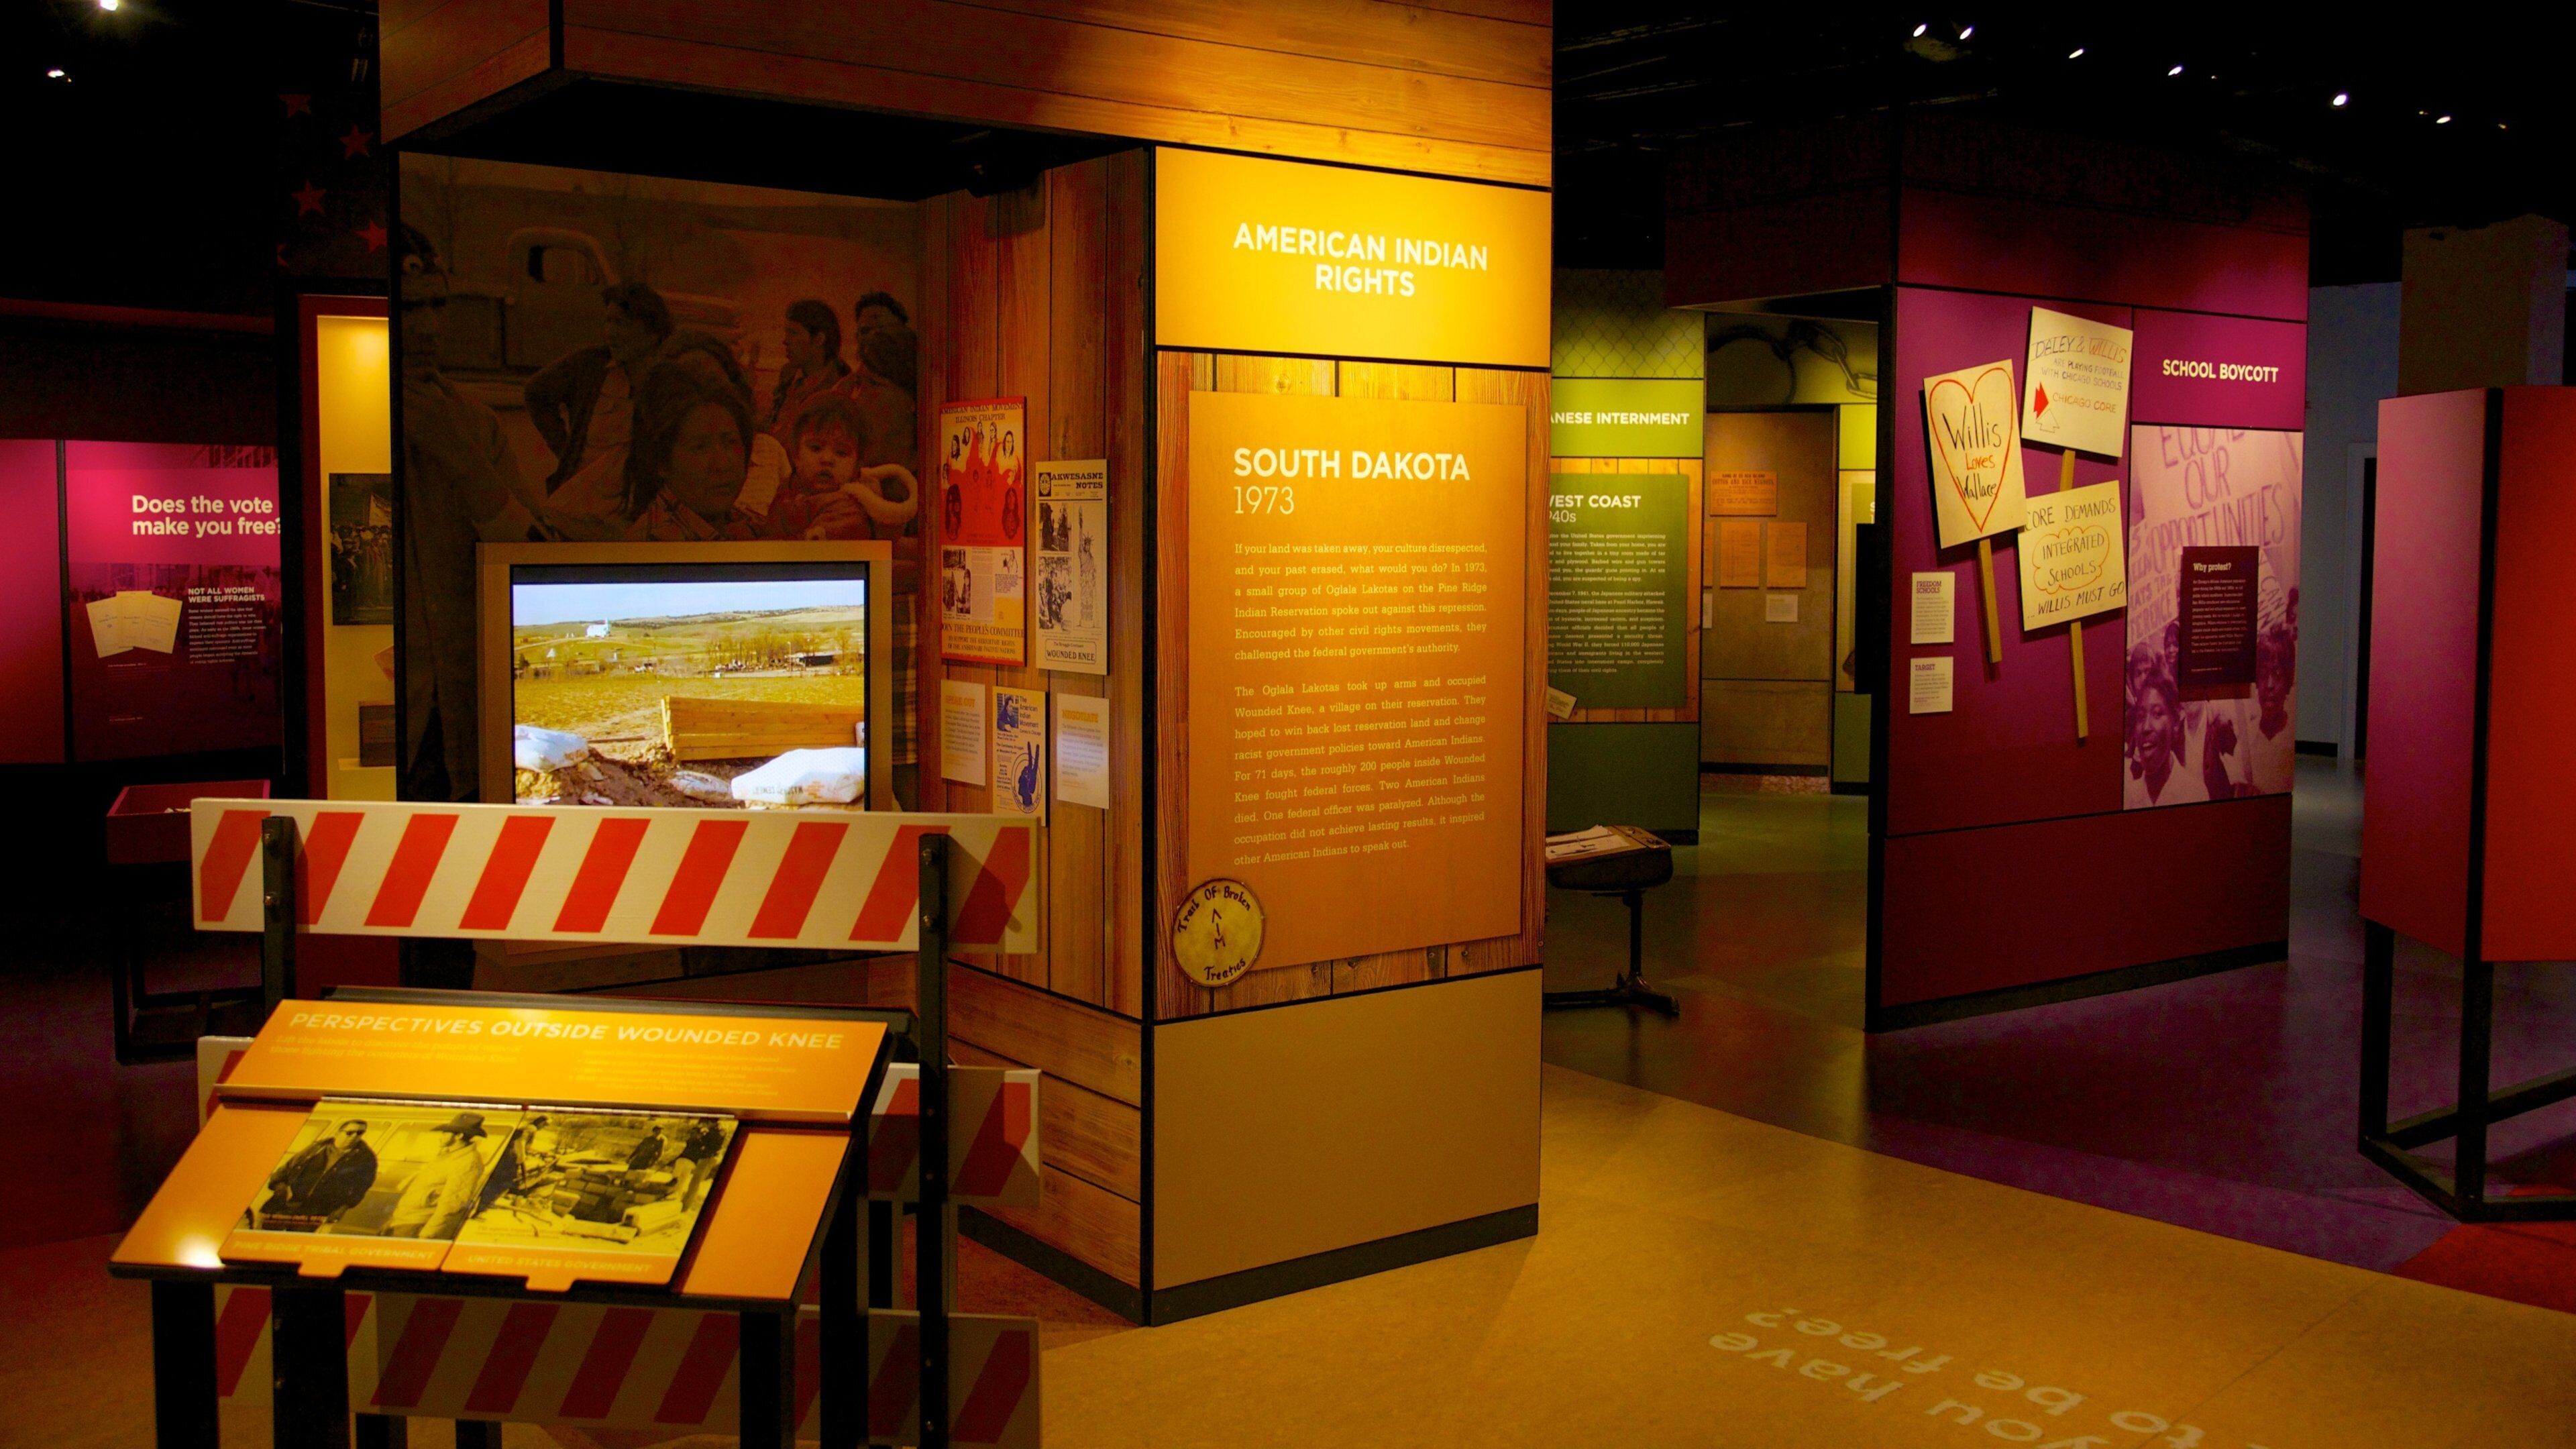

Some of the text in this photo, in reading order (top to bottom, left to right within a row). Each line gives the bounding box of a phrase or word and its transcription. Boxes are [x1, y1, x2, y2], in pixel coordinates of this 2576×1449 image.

[1234, 223, 1487, 270] AMERICAN INDIAN
[1316, 264, 1415, 297] RIGHTS
[2033, 336, 2127, 364] DALEY & WILLIS
[2041, 366, 2123, 390] WITH CHICAGO SCHOOLS
[2067, 360, 2093, 374] PLAYING
[2094, 366, 2125, 379] FOOTBALL
[2162, 359, 2279, 383] SCHOOL BOYCOTT
[2052, 392, 2116, 413] CHICAGO CORE
[979, 413, 1005, 422] CHAPTER
[1597, 413, 1690, 425] INTERNMENT
[1942, 402, 2002, 451] Willis
[1234, 447, 1470, 480] SOUTH DAKOTA
[1966, 453, 1996, 471] Loves
[1956, 473, 1997, 500] Wallace
[2185, 445, 2231, 510] OUR
[132, 495, 273, 514] Does the vote
[1234, 486, 1295, 515] 1973
[1589, 495, 1642, 508] COAST
[2065, 498, 2116, 523] DEMANDS
[132, 517, 189, 535] make
[195, 520, 232, 538] you
[1235, 543, 1487, 556] If your land was taken away, your culture disrespected,
[2042, 533, 2104, 560] INTEGRATED
[1234, 561, 1487, 577] and your past erased, what would you do? In 1973,
[2047, 561, 2097, 586] SCHOOLS
[2193, 562, 2232, 573] Why protest?
[188, 594, 266, 604] WERE SUFFRAGISTS
[1235, 582, 1487, 598] a small group of Oglala Lakotas on the Pine Ridge
[2077, 586, 2104, 606] MUST
[2109, 580, 2125, 598] GO
[1234, 602, 1486, 619] Indian Reservation spoke out against this repression.
[1235, 622, 1487, 640] Encouraged by other civil rights movements, they
[1046, 649, 1095, 661] WOUNDED KNEE
[1234, 642, 1460, 661] challenged the federal government's authority.
[1019, 704, 1038, 712] American
[1224, 885, 1251, 911] Broken
[1203, 958, 1246, 981] Treaties
[290, 1012, 845, 1051] PERSPECTIVES OUTSIDE WOUNDED KNEE
[350, 1247, 435, 1259] GOVERNMENT
[468, 1255, 653, 1272] UNITED STATES GOVERNMENT
[1746, 1308, 1953, 1375] free?
[1709, 1332, 1904, 1403] have
[1974, 1371, 2088, 1416] be
